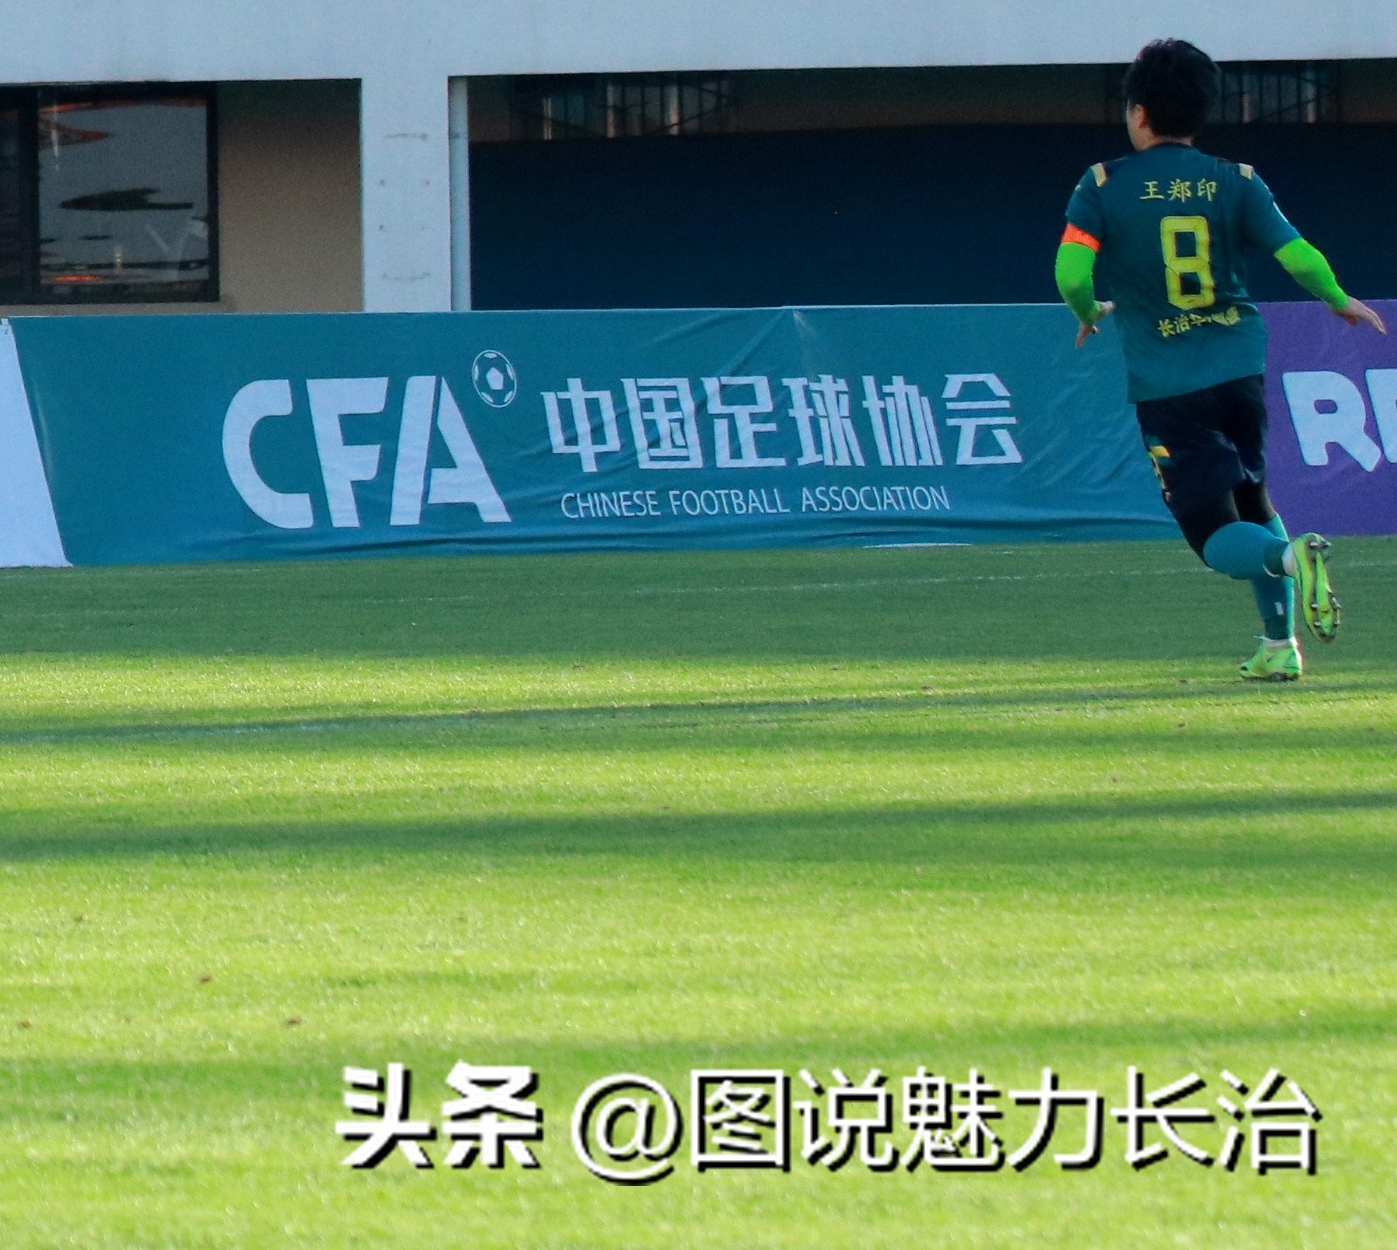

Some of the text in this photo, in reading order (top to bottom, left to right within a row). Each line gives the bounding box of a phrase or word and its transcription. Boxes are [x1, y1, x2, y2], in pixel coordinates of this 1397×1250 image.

[1139, 178, 1218, 203] 王郑印
[1160, 215, 1216, 311] 8
[222, 375, 512, 528] CFA
[541, 373, 1022, 473] 中国足球协会
[1282, 367, 1397, 472] R
[561, 485, 951, 519] CHINESE FOOTBALL ASSOCIATION
